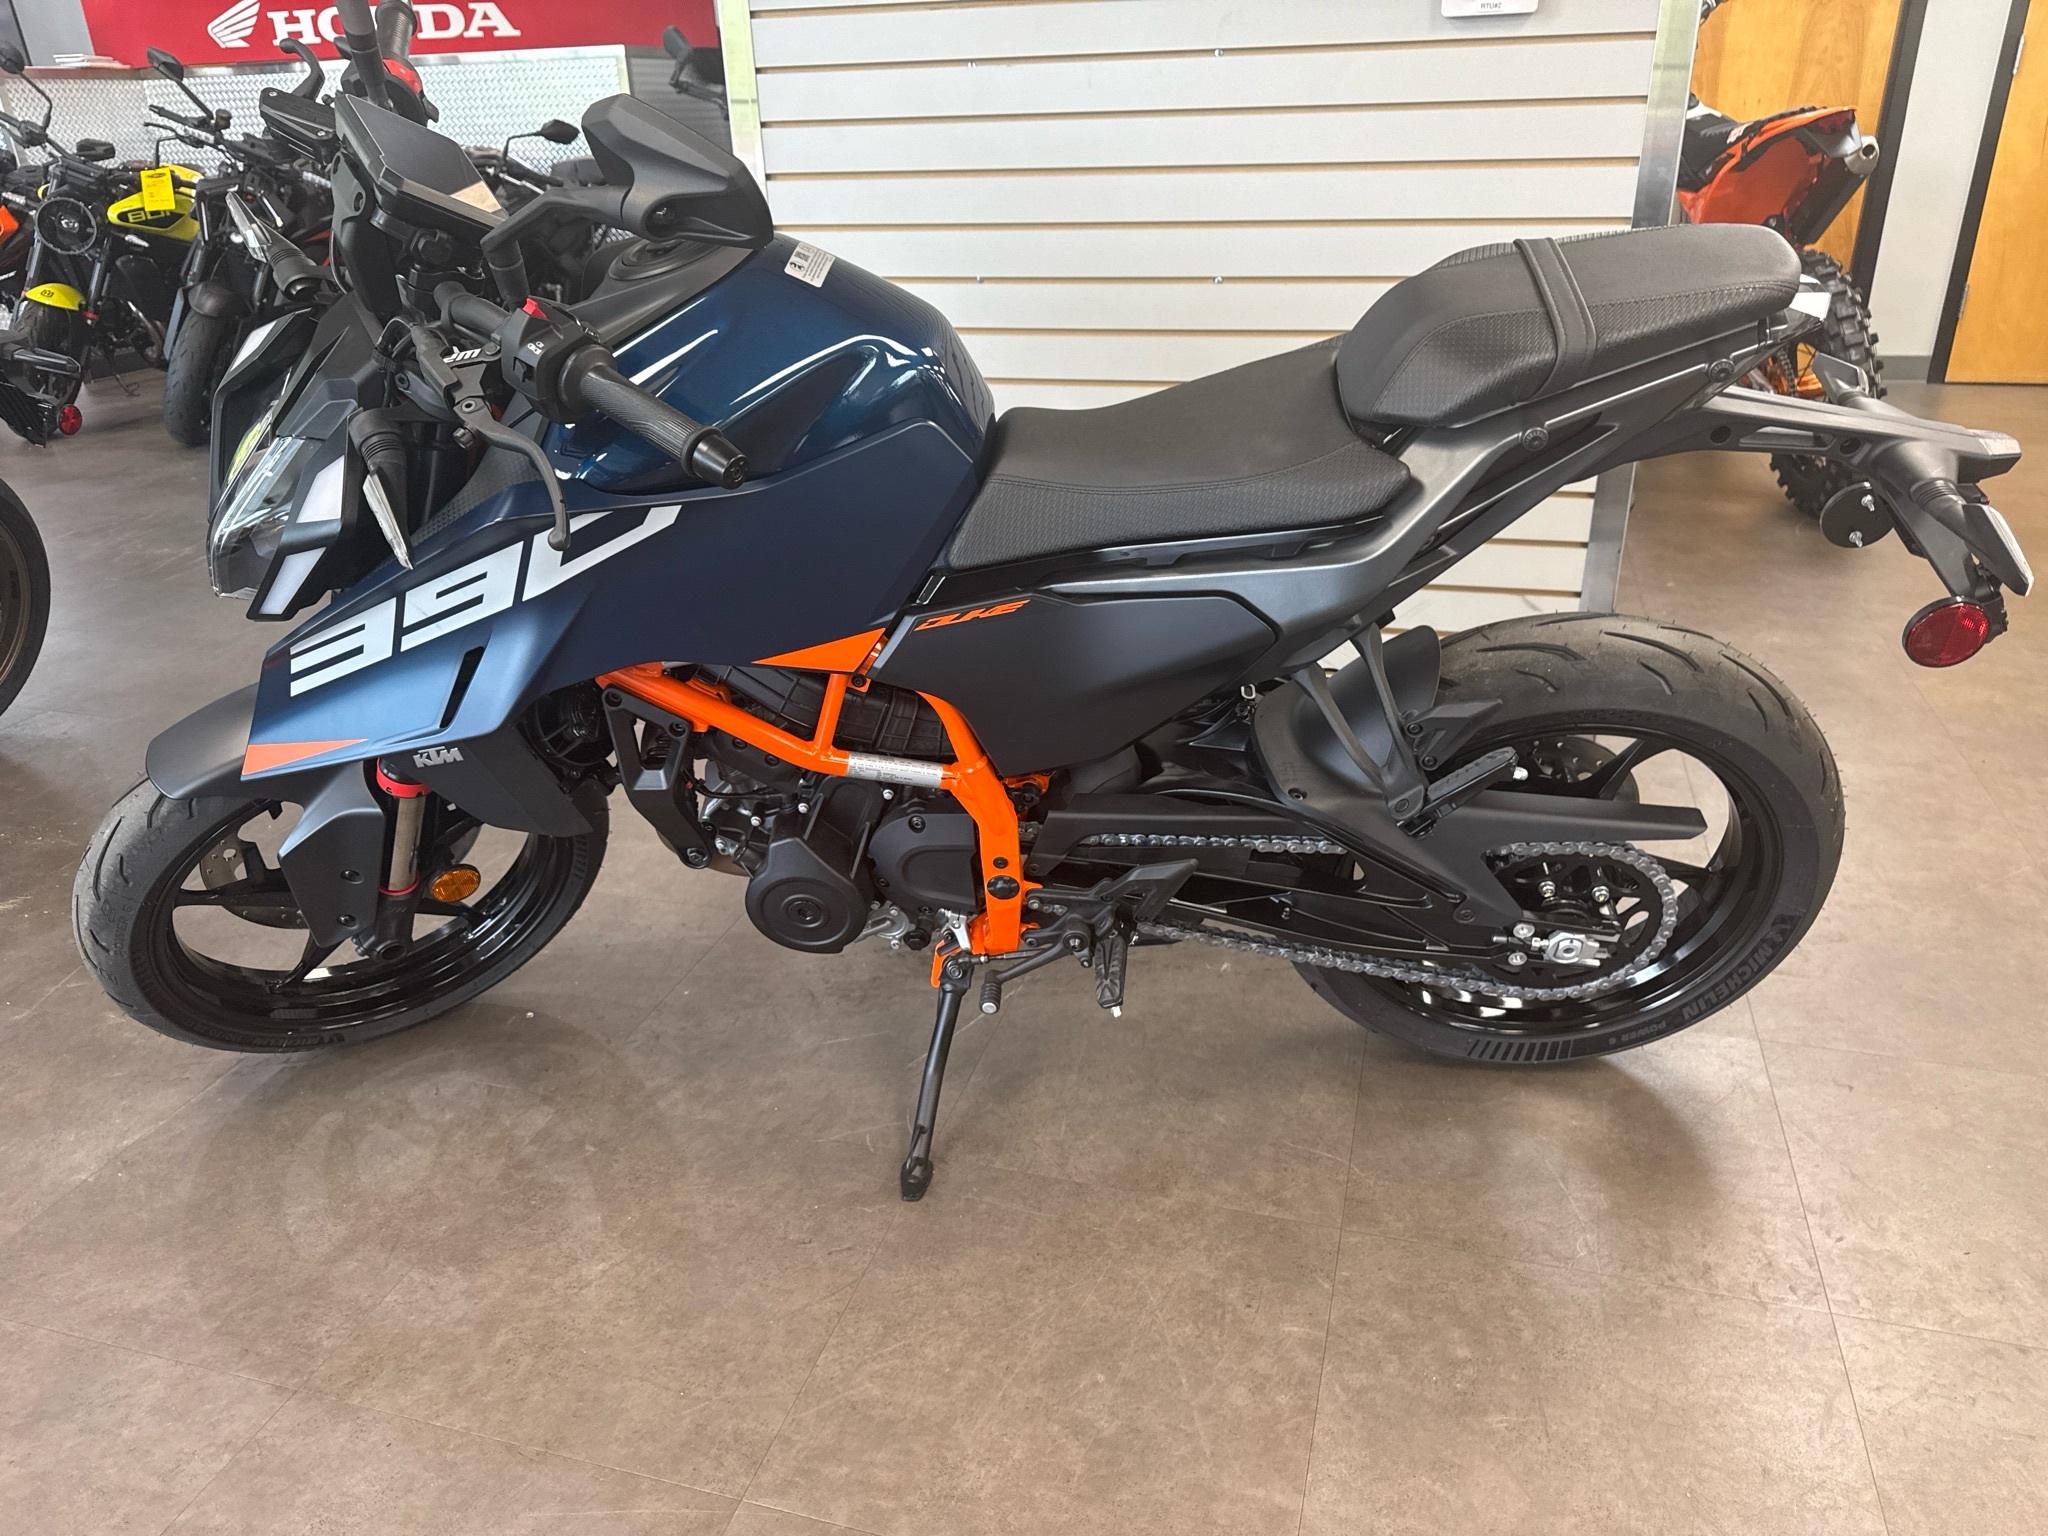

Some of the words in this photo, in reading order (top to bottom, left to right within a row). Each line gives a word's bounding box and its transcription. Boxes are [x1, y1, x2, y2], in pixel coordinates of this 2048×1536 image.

[267, 2, 521, 46] HODA
[290, 505, 683, 698] 390
[914, 599, 1032, 632] DUKE
[413, 746, 464, 768] KTM
[1681, 943, 1774, 1021] MICHELIN
[1620, 1020, 1668, 1042] POWER
